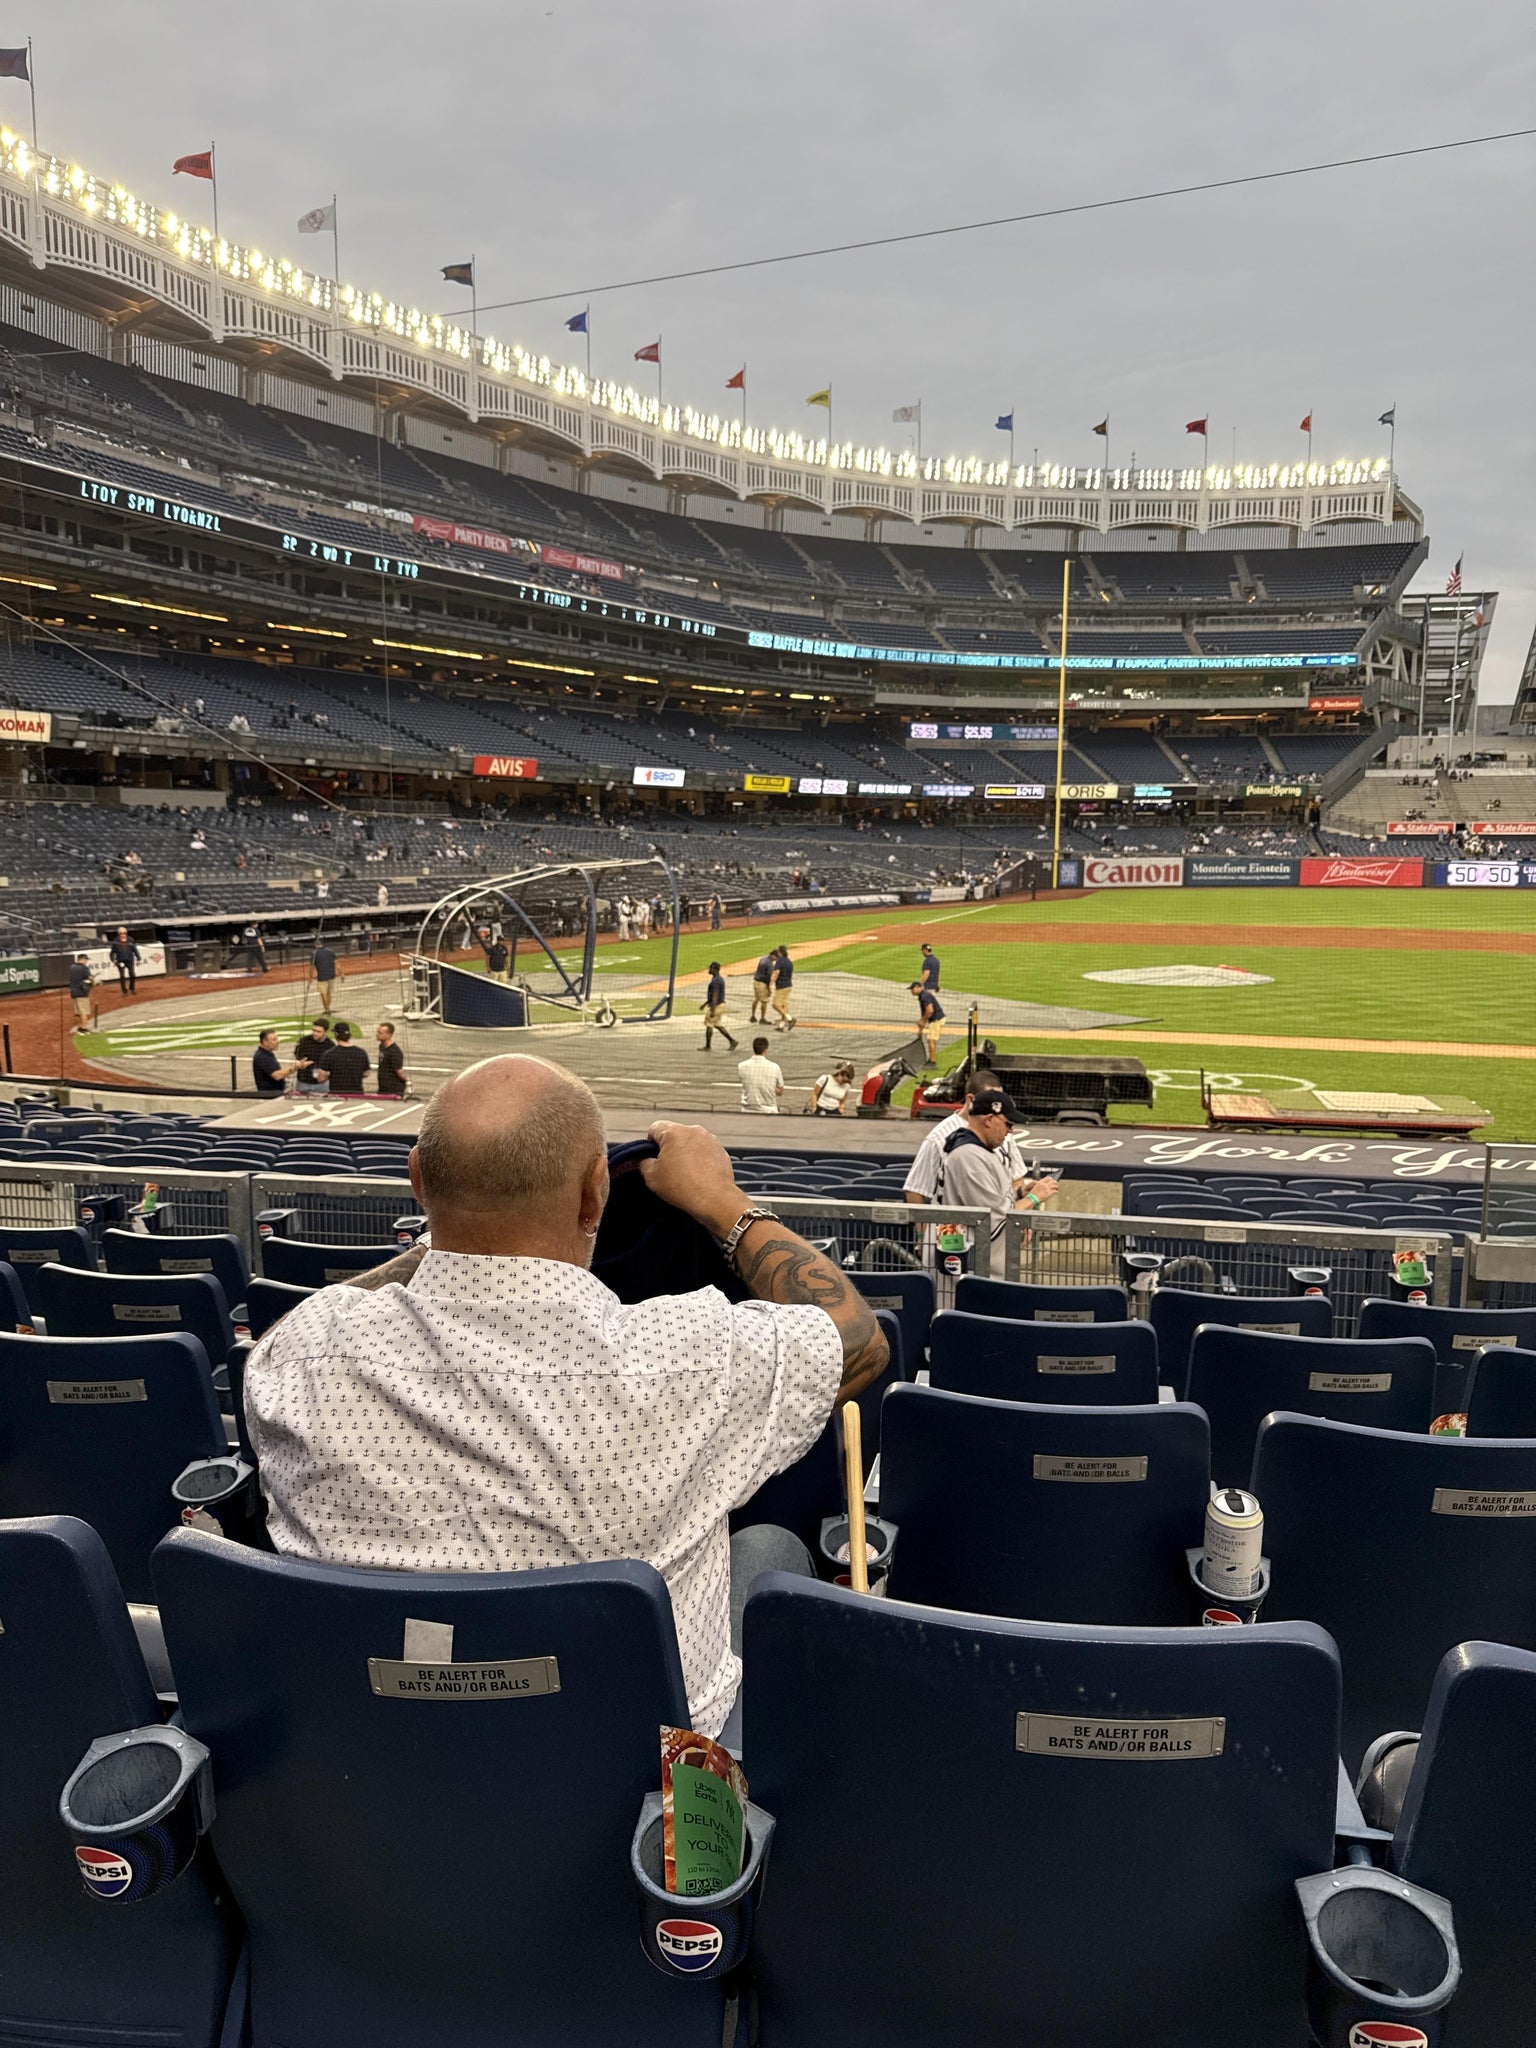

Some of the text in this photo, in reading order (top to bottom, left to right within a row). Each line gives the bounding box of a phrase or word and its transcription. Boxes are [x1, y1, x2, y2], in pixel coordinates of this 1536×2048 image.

[455, 527, 509, 553] PARTY DECK
[577, 556, 622, 579] PARTY DECK
[813, 641, 835, 656] SALE
[836, 643, 857, 658] NOW
[887, 650, 916, 661] SELLERS
[917, 652, 931, 662] AND
[932, 653, 955, 664] KIOSKS
[956, 655, 1000, 666] THROUGHOUT
[1001, 656, 1014, 667] THE
[1015, 656, 1045, 667] STADIUM
[1168, 658, 1200, 668] FASTER
[1201, 658, 1224, 668] THAN
[1224, 658, 1242, 667] THE
[1244, 658, 1270, 667] PITCH
[1271, 657, 1303, 667] CLOCK
[489, 759, 524, 777] AVIS
[1067, 786, 1105, 797] ORIS
[1246, 785, 1302, 797] Poland Spring
[1086, 861, 1181, 884] Canon
[1192, 863, 1291, 874] Montefiore Einstein
[1328, 864, 1393, 878] Budweiser
[10, 968, 39, 984] Spring
[1133, 1134, 1355, 1165] York
[110, 1391, 131, 1399] BALLS
[1051, 1469, 1130, 1477] BATS AND/OR BALLS
[1077, 1462, 1100, 1470] ALERT
[1468, 1495, 1479, 1503] BE
[1481, 1496, 1506, 1504] ALERT
[1452, 1503, 1536, 1512] BATS AND/OR BALLS
[418, 1669, 506, 1681] BE ALERT FOR
[399, 1679, 530, 1693] BATS AND/OR BALLS
[1074, 1726, 1169, 1739] BE ALERT FOR
[1049, 1737, 1192, 1752] BATS AND/OR BALLS
[694, 1781, 716, 1795] Uber
[695, 1790, 718, 1804] Eats
[714, 1831, 729, 1850] TO
[688, 1839, 725, 1858] YOUR
[79, 1863, 128, 1878] PEPSI
[659, 1931, 718, 1952] PEPSI
